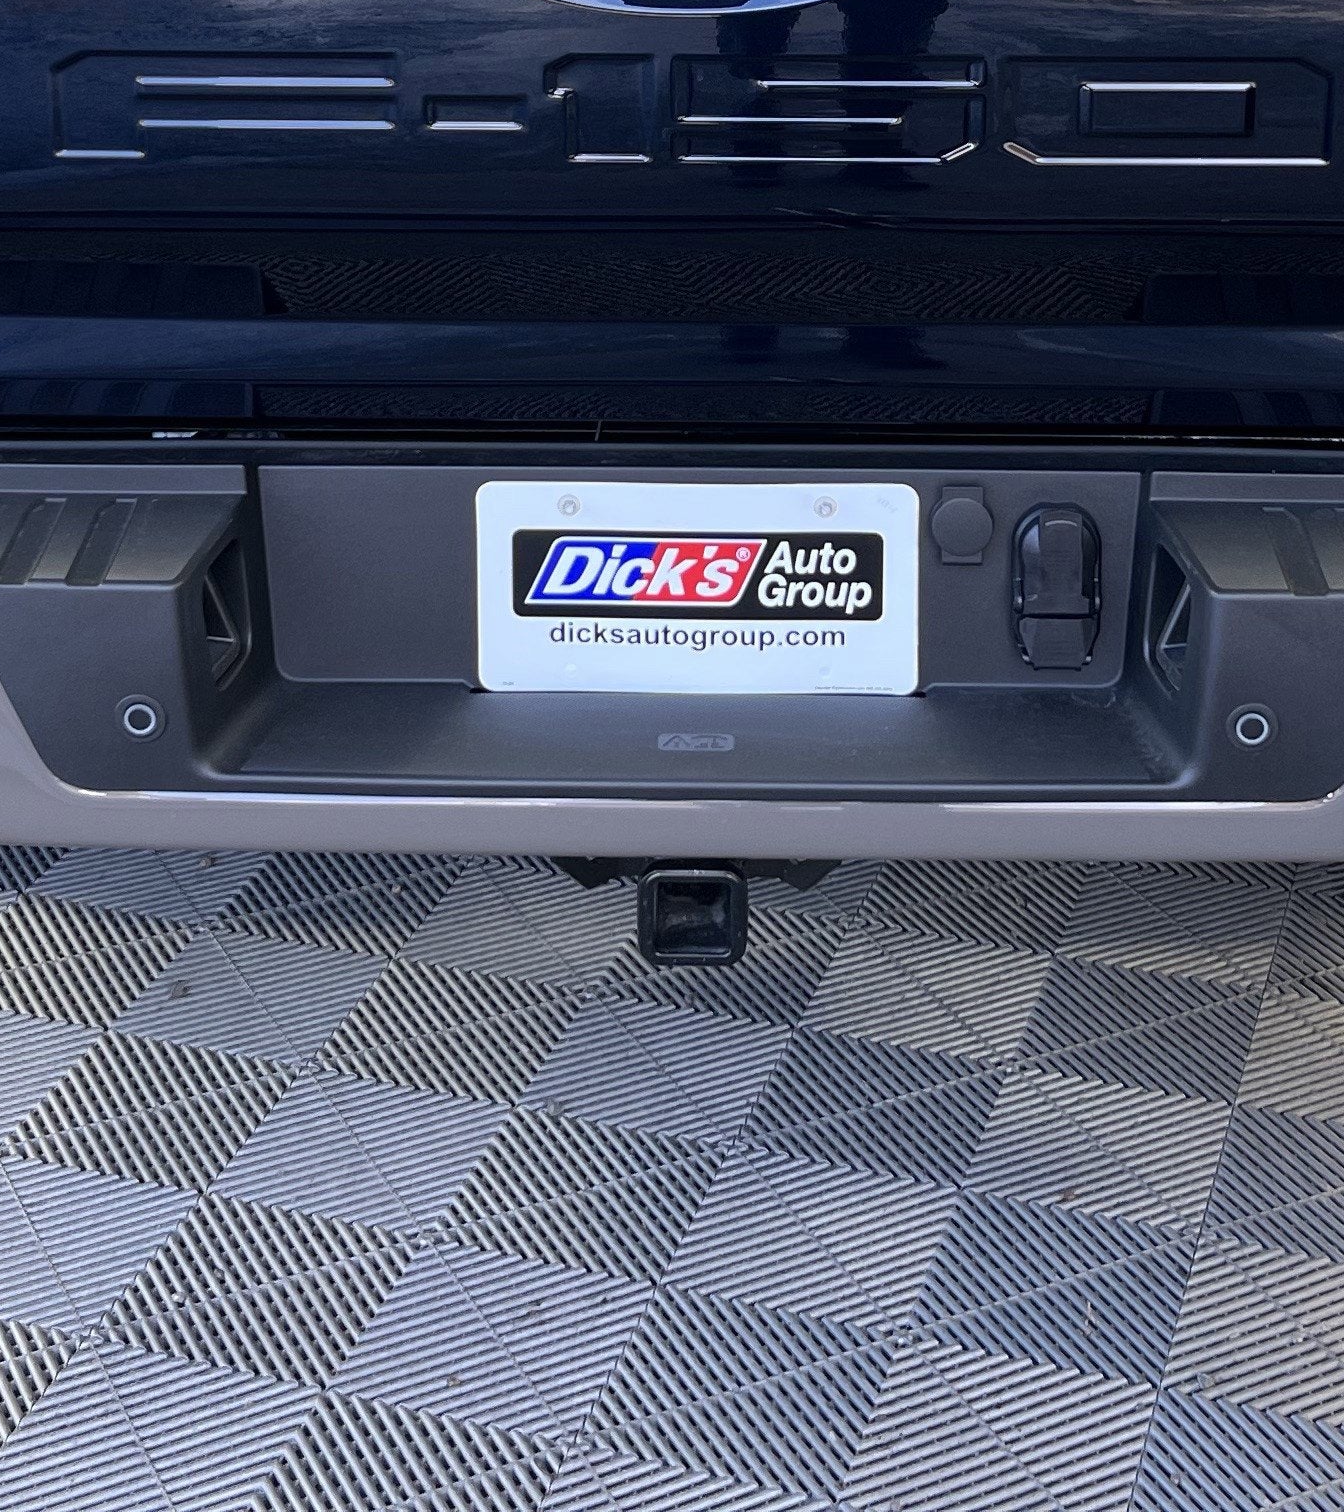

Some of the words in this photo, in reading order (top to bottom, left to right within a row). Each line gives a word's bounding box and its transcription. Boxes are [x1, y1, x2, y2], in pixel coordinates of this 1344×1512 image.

[53, 48, 1334, 168] F-150
[765, 540, 856, 575] Auto
[757, 573, 872, 614] Group
[550, 622, 846, 651] dicksautogroup.com
